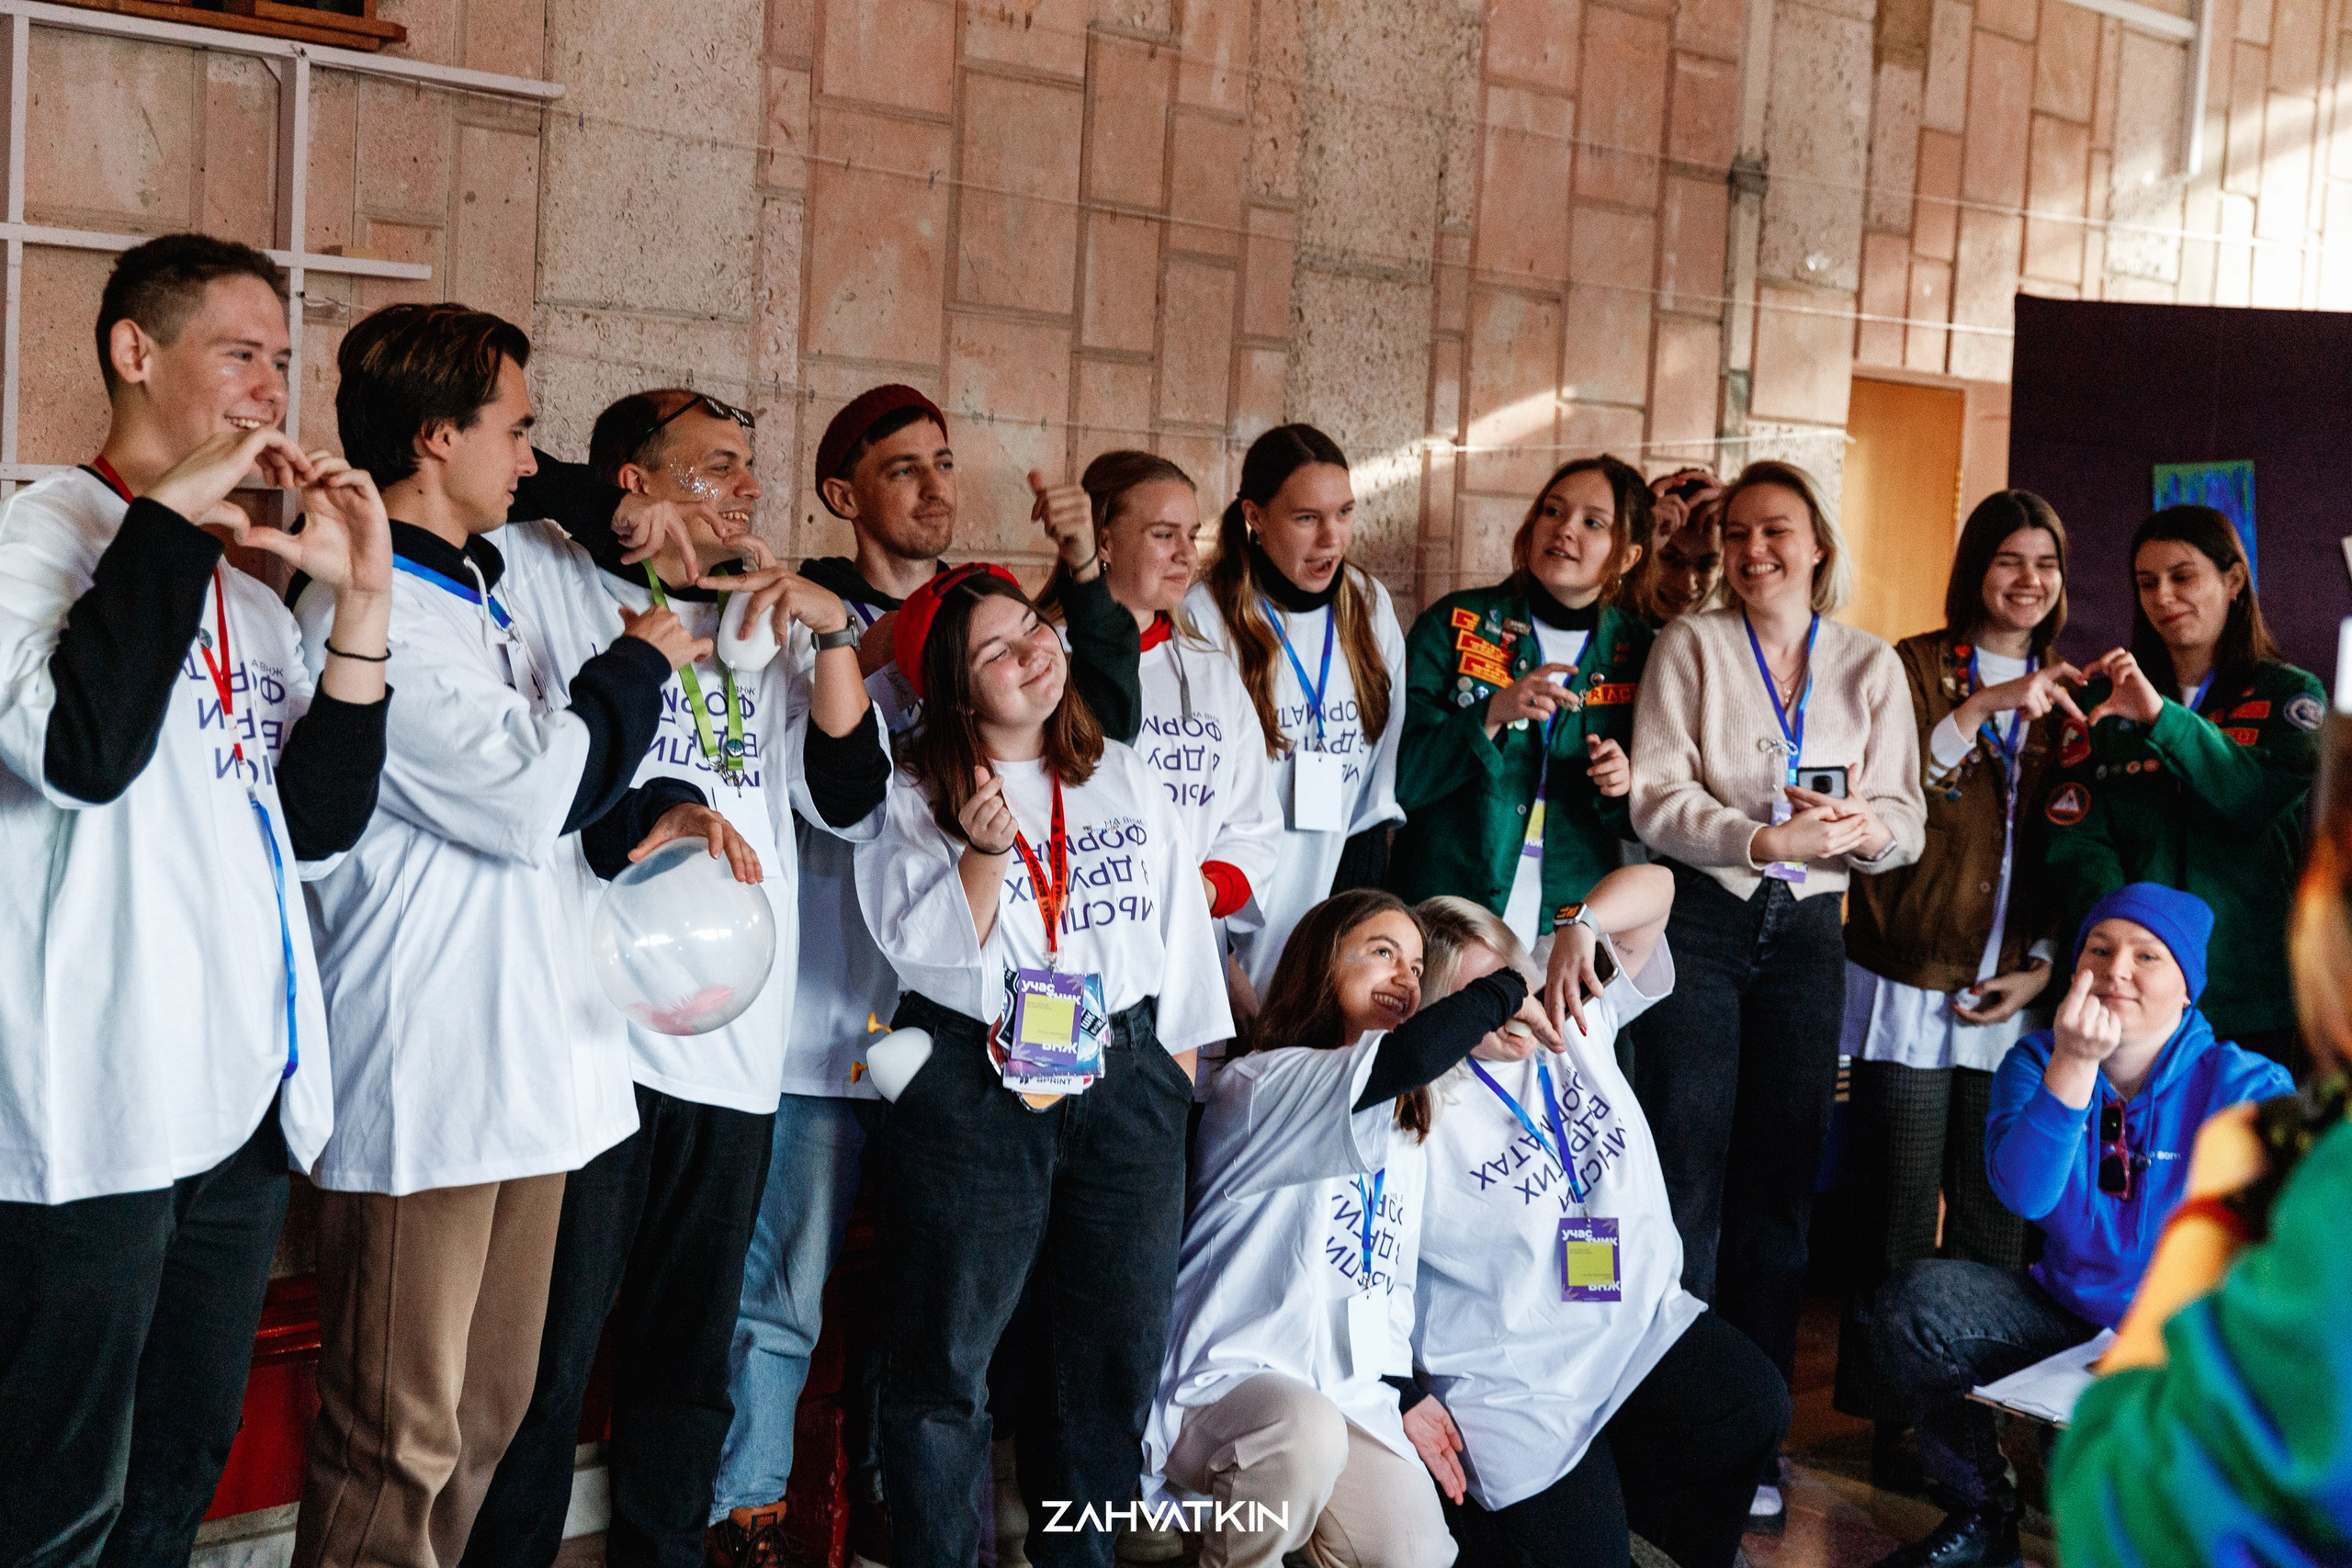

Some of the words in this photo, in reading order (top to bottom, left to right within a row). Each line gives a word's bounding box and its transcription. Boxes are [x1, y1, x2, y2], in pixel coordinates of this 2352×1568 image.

[1141, 716, 1222, 743] ФОРМ
[1147, 745, 1205, 773] ДРУ
[1004, 855, 1134, 905] ДРУХ
[1022, 979, 1056, 993] учас
[1561, 1228, 1593, 1242] учас
